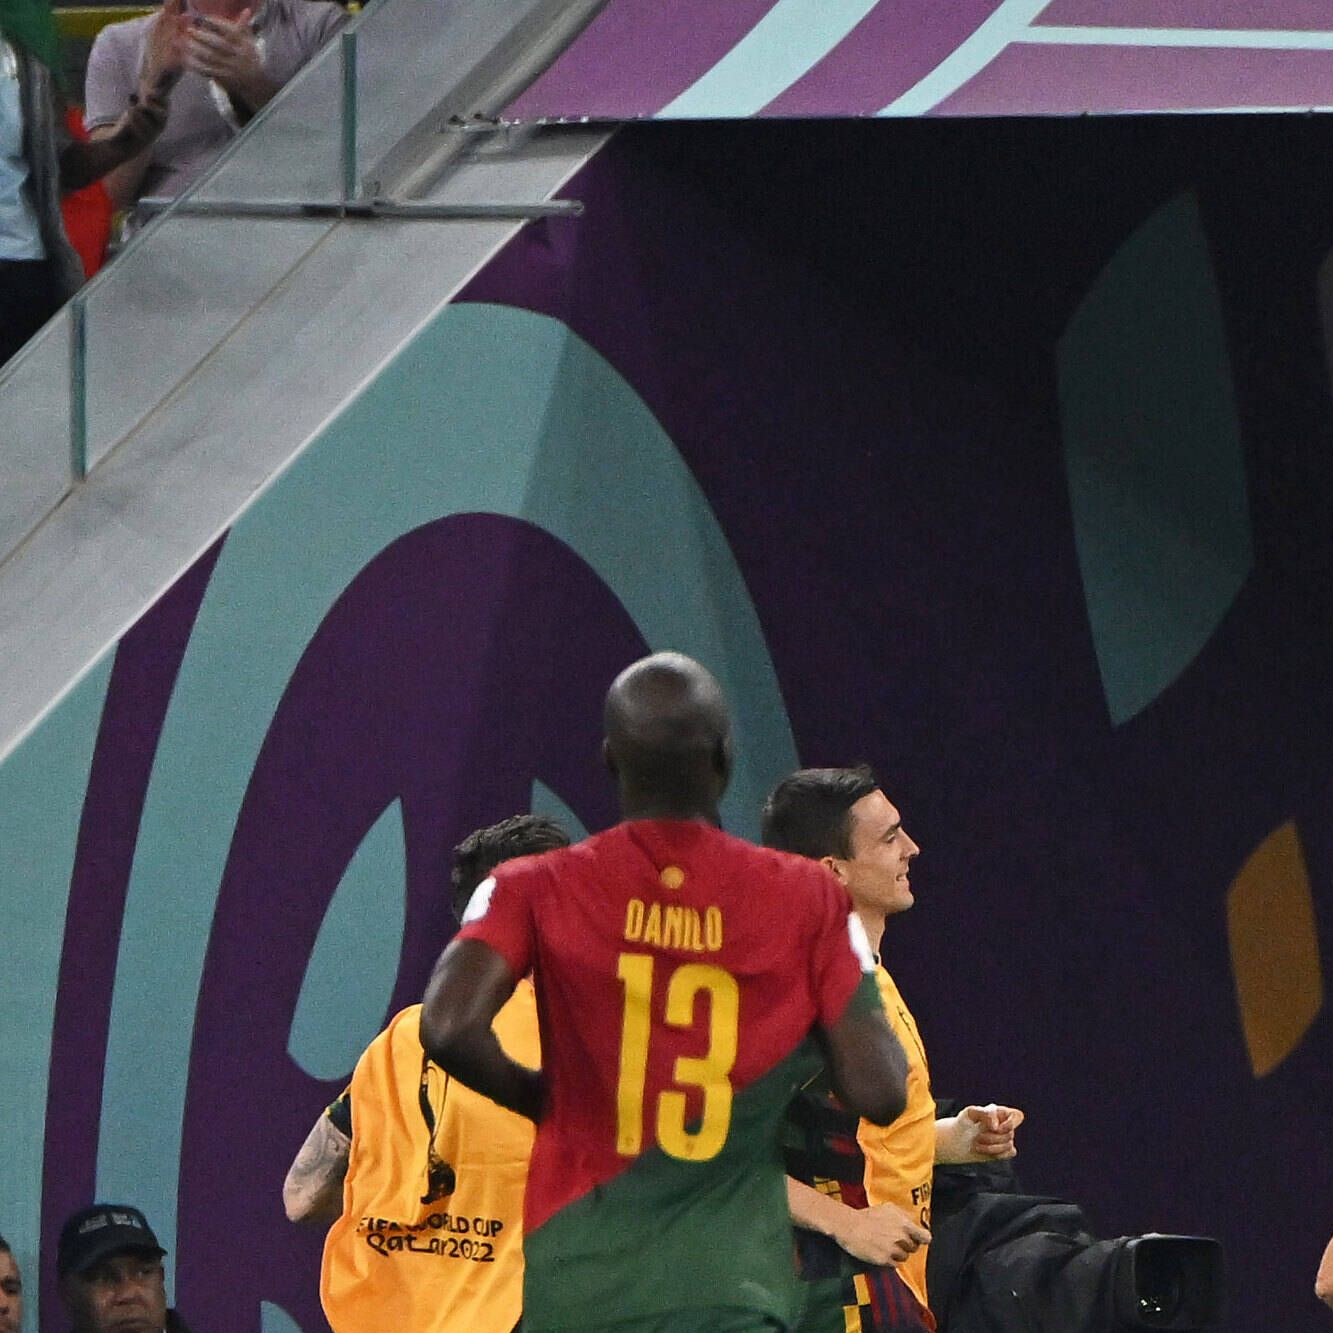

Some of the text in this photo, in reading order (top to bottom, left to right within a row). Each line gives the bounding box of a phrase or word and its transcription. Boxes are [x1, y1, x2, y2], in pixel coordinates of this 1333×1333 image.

[623, 898, 723, 952] DANILO
[616, 952, 740, 1163] 13
[472, 1217, 503, 1237] CUP
